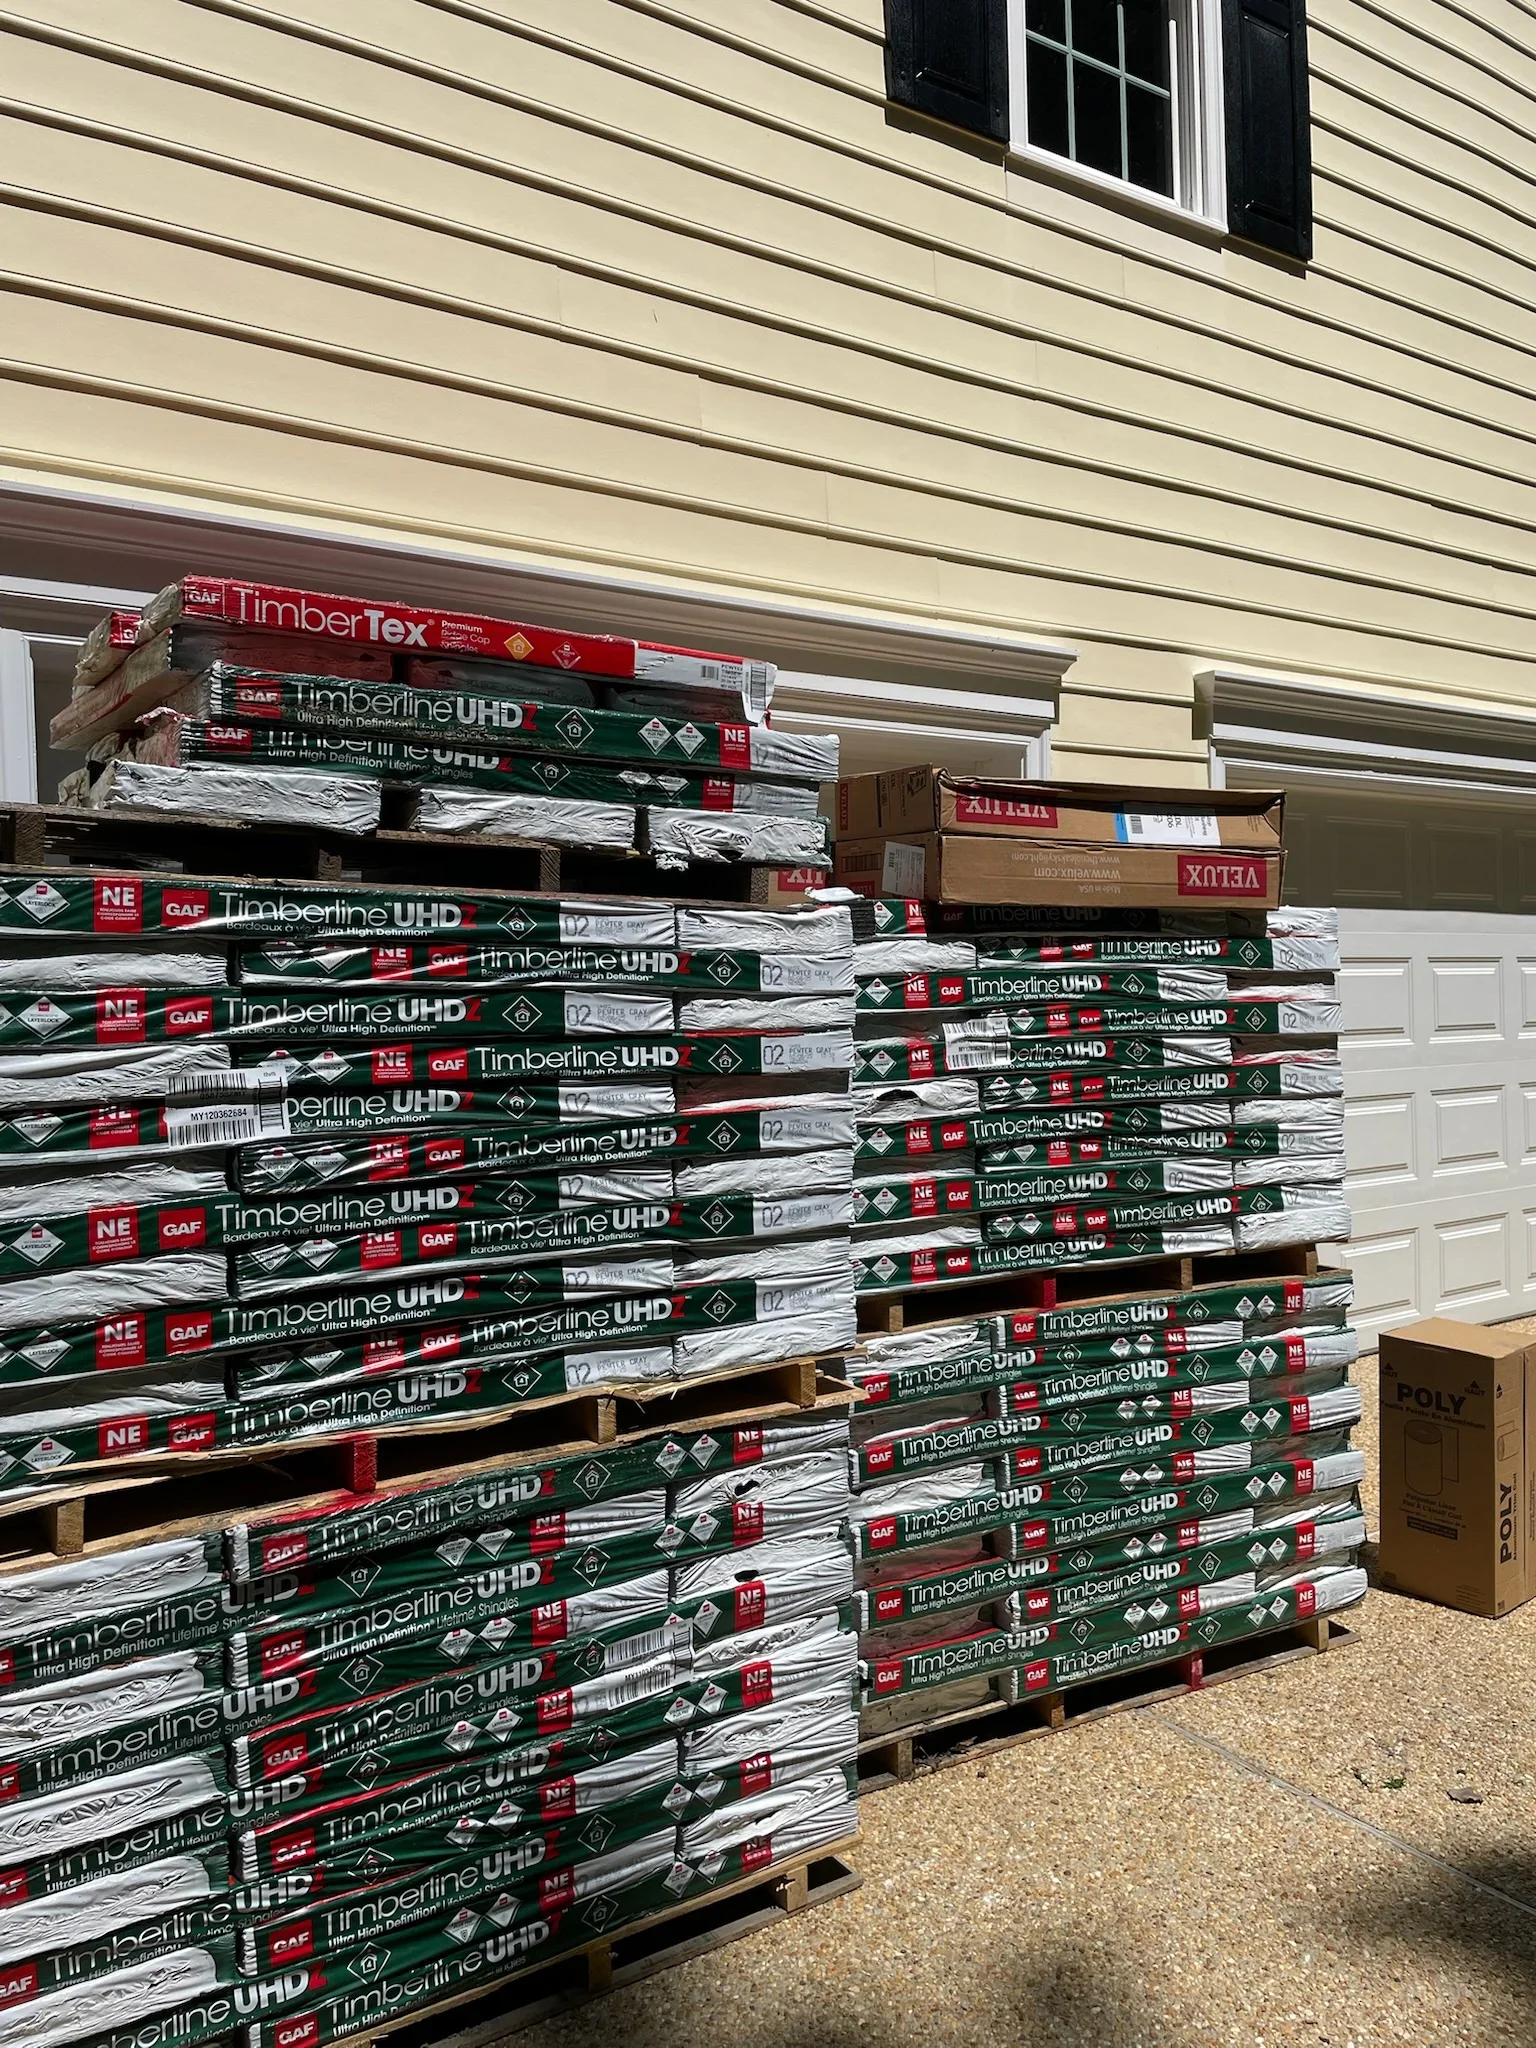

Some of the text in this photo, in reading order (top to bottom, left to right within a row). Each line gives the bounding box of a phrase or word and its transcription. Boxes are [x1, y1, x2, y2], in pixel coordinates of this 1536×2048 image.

[441, 620, 483, 634] Premium
[467, 633, 491, 645] Cap
[240, 688, 278, 702] GAF
[297, 712, 324, 725] Ultra
[327, 714, 354, 728] High
[210, 726, 248, 740] GAF
[725, 729, 746, 742] NE
[300, 748, 326, 762] High
[330, 751, 382, 768] Definition
[432, 763, 473, 779] Shingles
[1011, 852, 1121, 866] www.thenoleakskylight.com
[1034, 867, 1121, 880] www.velux.com
[1187, 864, 1261, 889] VELUX
[102, 886, 135, 907] NE
[1079, 884, 1121, 894] Made in USA
[166, 903, 205, 917] GAF
[219, 892, 388, 926] Timberline
[226, 921, 282, 933] Bardeaux
[318, 927, 344, 936] Ultra
[346, 927, 374, 938] High
[375, 928, 428, 937] Definition
[564, 915, 590, 937] 02
[762, 966, 783, 986] 02
[908, 980, 924, 992] NE
[942, 986, 961, 996] GAF
[967, 977, 1060, 995] Timberline
[104, 1000, 138, 1018] NE
[170, 1010, 208, 1024] GAF
[222, 997, 391, 1024] Timberline
[566, 1004, 592, 1027] 02
[321, 1023, 347, 1034] Ultra
[350, 1024, 377, 1035] High
[379, 1024, 430, 1033] Definition
[378, 1052, 406, 1067] NE
[432, 1060, 464, 1072] GAF
[475, 1045, 618, 1072] Timberline
[911, 1050, 930, 1061] NE
[909, 1115, 1062, 1141] NE GAF Timberline
[914, 1185, 933, 1199] NE
[948, 1191, 969, 1201] GAF
[975, 1177, 1066, 1200] Timberline
[97, 1218, 131, 1239] NE
[163, 1221, 201, 1236] GAF
[215, 1193, 386, 1233] Timberline
[422, 1234, 454, 1247] GAF
[465, 1211, 608, 1244] Timberline
[762, 1290, 784, 1312] 02
[103, 1320, 138, 1340] NE
[169, 1325, 208, 1341] GAF
[221, 1293, 391, 1335] Timberline
[1014, 1323, 1034, 1334] GAF
[1288, 1295, 1301, 1307] NE
[229, 1331, 287, 1346] Bardeaux
[322, 1319, 348, 1331] Ultra
[351, 1316, 378, 1328] High
[380, 1309, 430, 1324] Definition
[552, 1325, 643, 1342] Ultra High Definition
[1289, 1345, 1302, 1356] NE
[897, 1356, 993, 1389] Timberline
[1293, 1403, 1307, 1414] NE
[1397, 1381, 1467, 1416] POLY
[107, 1425, 140, 1446] NE
[737, 1430, 759, 1443] NE
[869, 1424, 997, 1465] GAF Timberline
[1298, 1469, 1311, 1480] NE
[871, 1526, 894, 1538] GAF
[901, 1495, 1000, 1533] Timberline
[1500, 1483, 1513, 1564] POLY
[740, 1589, 761, 1606] NE
[879, 1567, 1006, 1611] GAF Timberline
[315, 1582, 473, 1651] Timberline
[350, 1637, 377, 1655] High
[478, 1596, 519, 1618] Shingles
[24, 1597, 217, 1664] Timberline
[34, 1662, 65, 1680] Ultra
[69, 1653, 100, 1672] High
[878, 1639, 1006, 1683] GAF Timberline
[746, 1668, 767, 1687] NE
[1027, 1669, 1047, 1681] GAF
[267, 1745, 304, 1767] GAF
[315, 1683, 474, 1751] Timberline
[273, 1931, 309, 1954] GAF
[321, 1861, 478, 1937] Timberline
